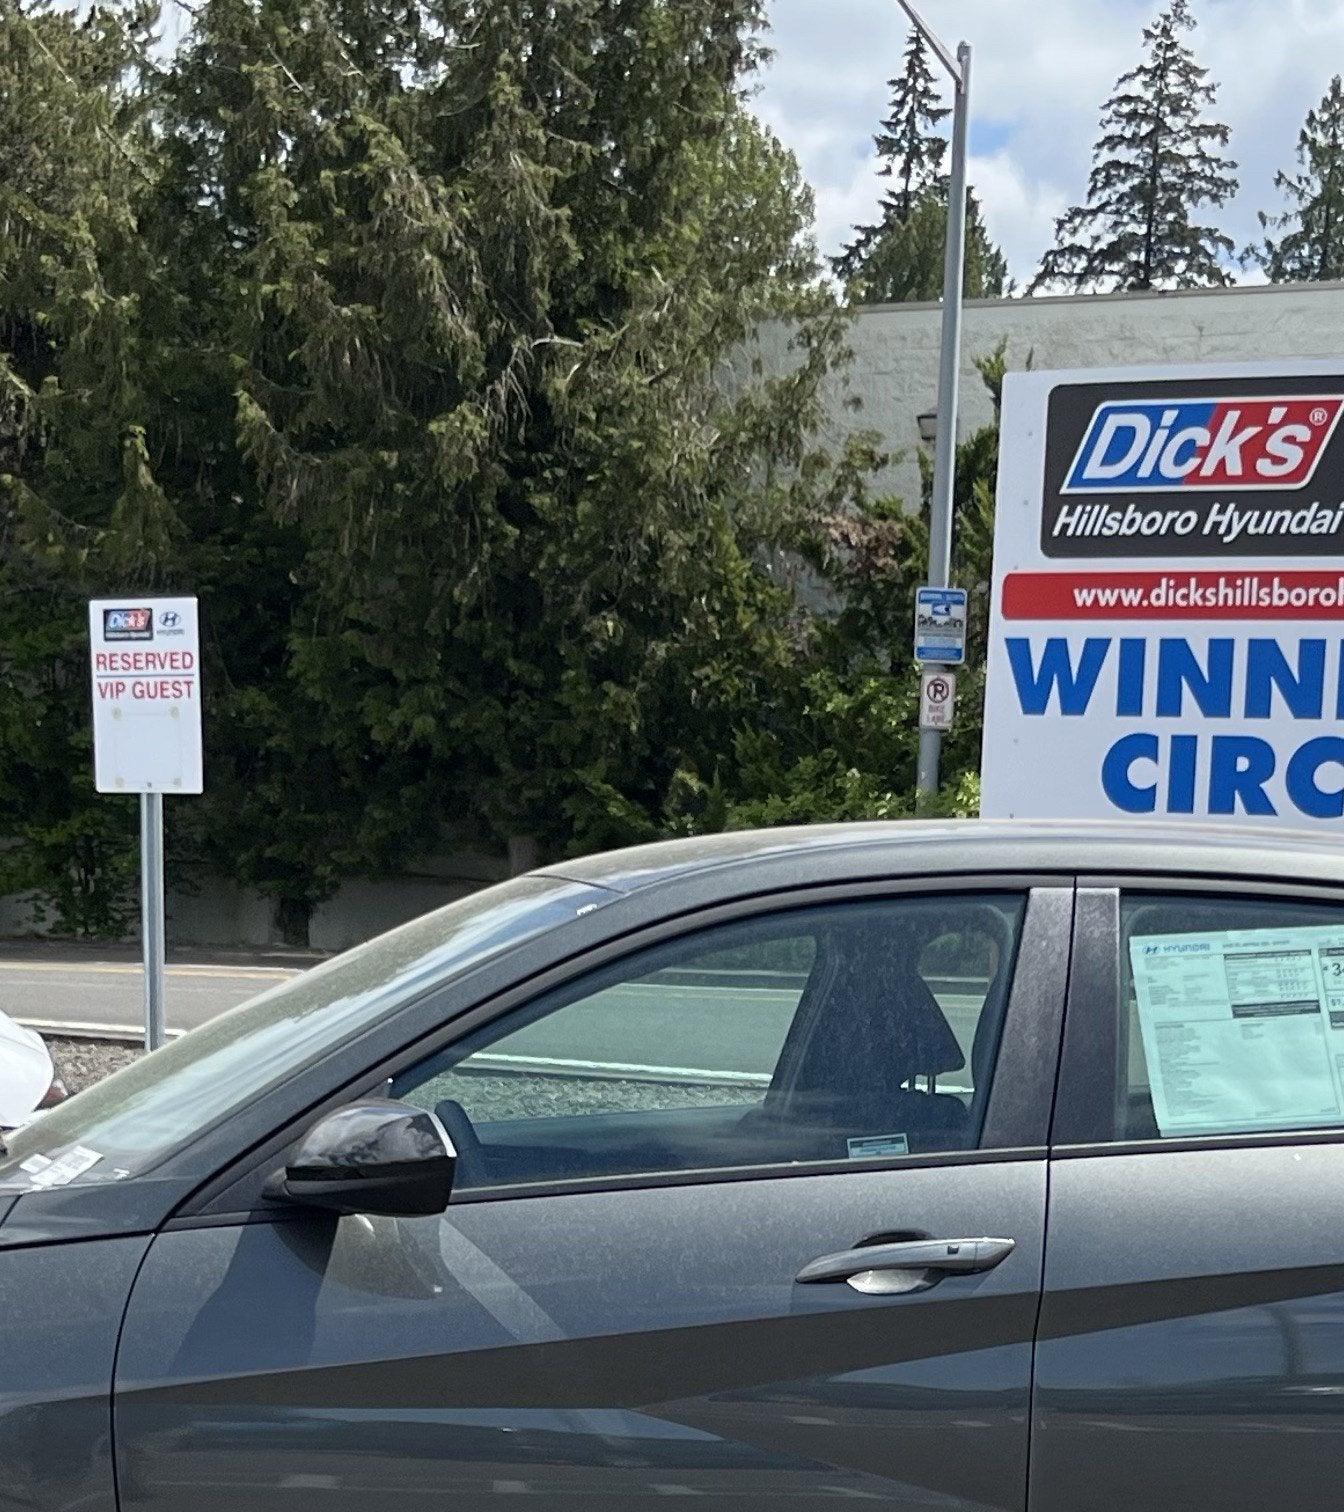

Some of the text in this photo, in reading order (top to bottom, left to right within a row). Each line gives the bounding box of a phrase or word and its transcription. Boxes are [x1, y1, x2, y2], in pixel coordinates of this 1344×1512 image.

[1081, 406, 1313, 480] Dick's
[1051, 503, 1200, 537] Hillsboro
[95, 651, 194, 672] RESERVED
[97, 680, 194, 700] VIP GUEST
